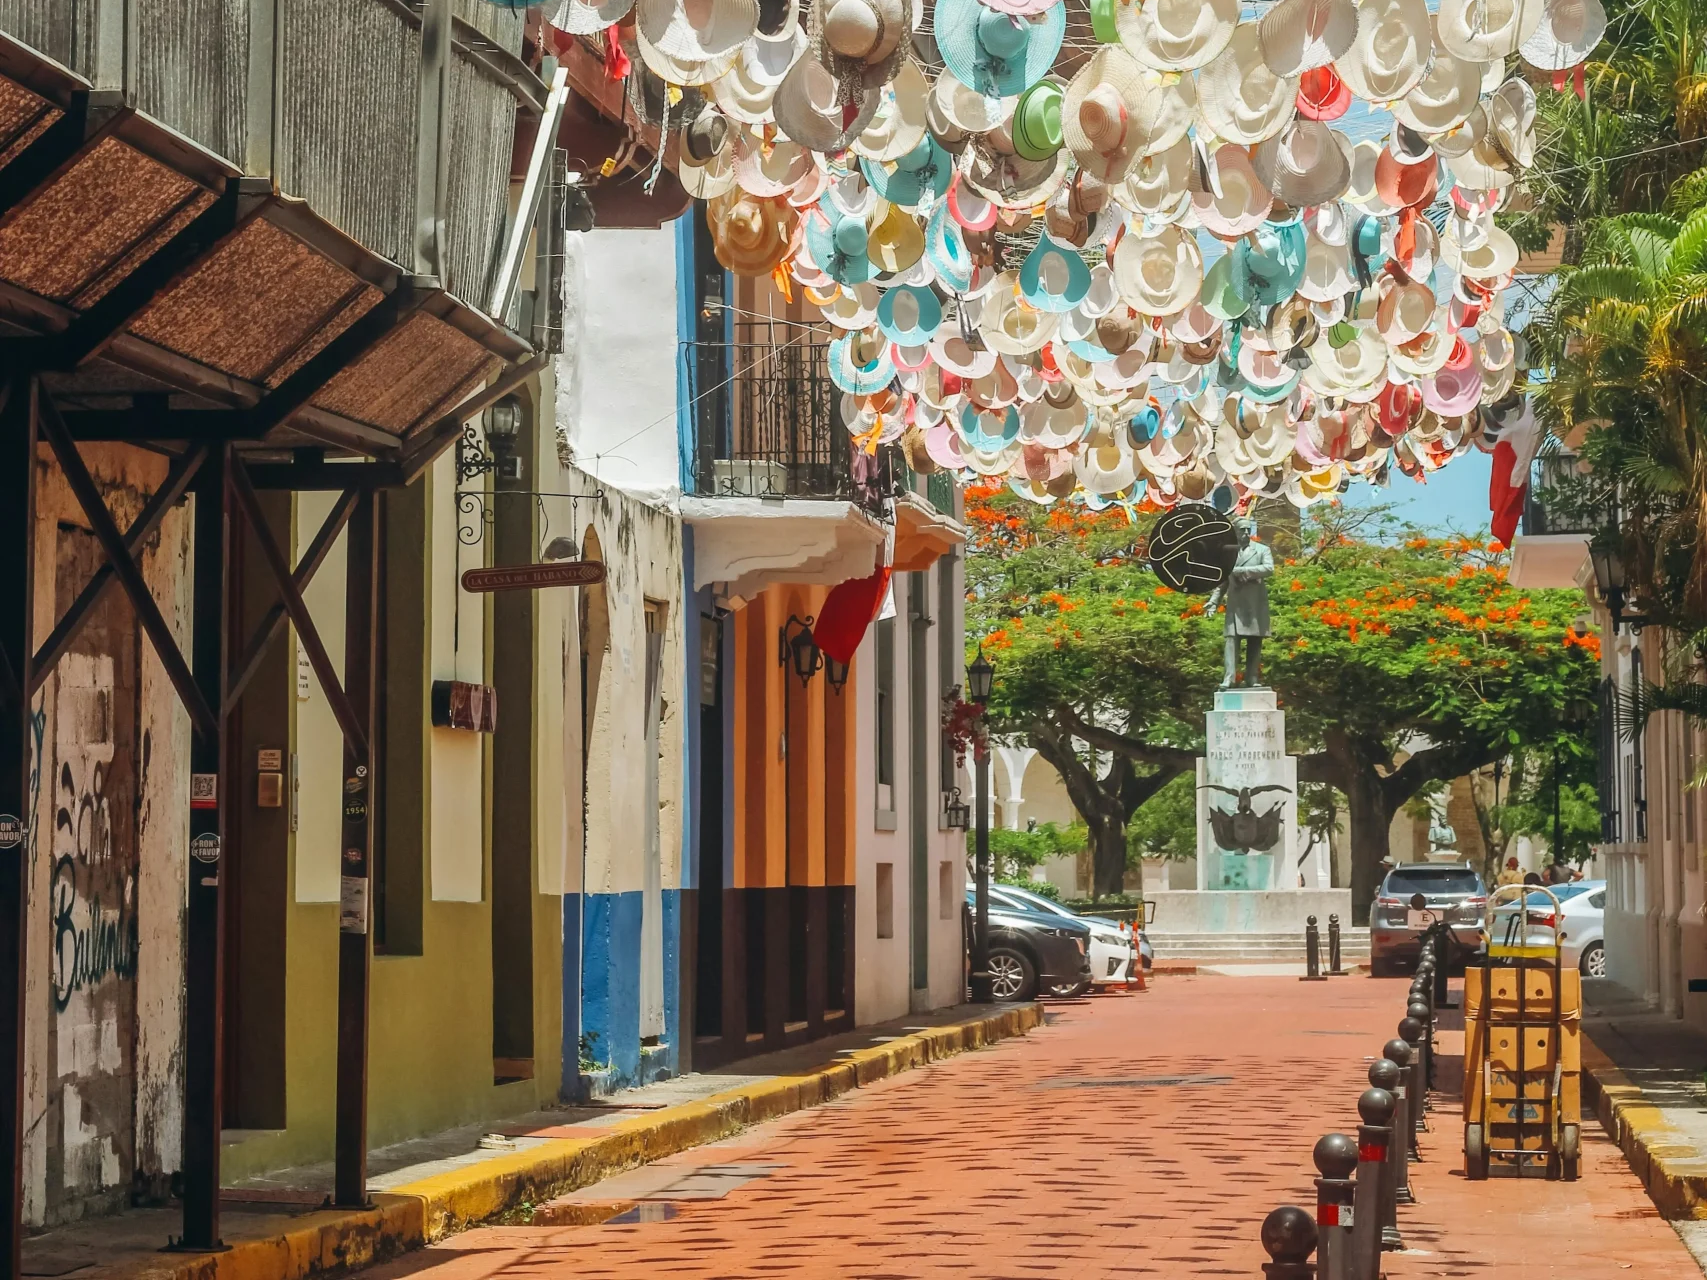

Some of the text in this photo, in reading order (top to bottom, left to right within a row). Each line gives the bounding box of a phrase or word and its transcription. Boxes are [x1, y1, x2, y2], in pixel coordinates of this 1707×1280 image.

[471, 578, 482, 586] LA
[484, 575, 511, 585] CASA
[533, 570, 577, 581] HABANO
[346, 806, 365, 815] 1954
[0, 822, 12, 831] ON
[0, 831, 20, 841] AVOR
[198, 839, 214, 848] RON
